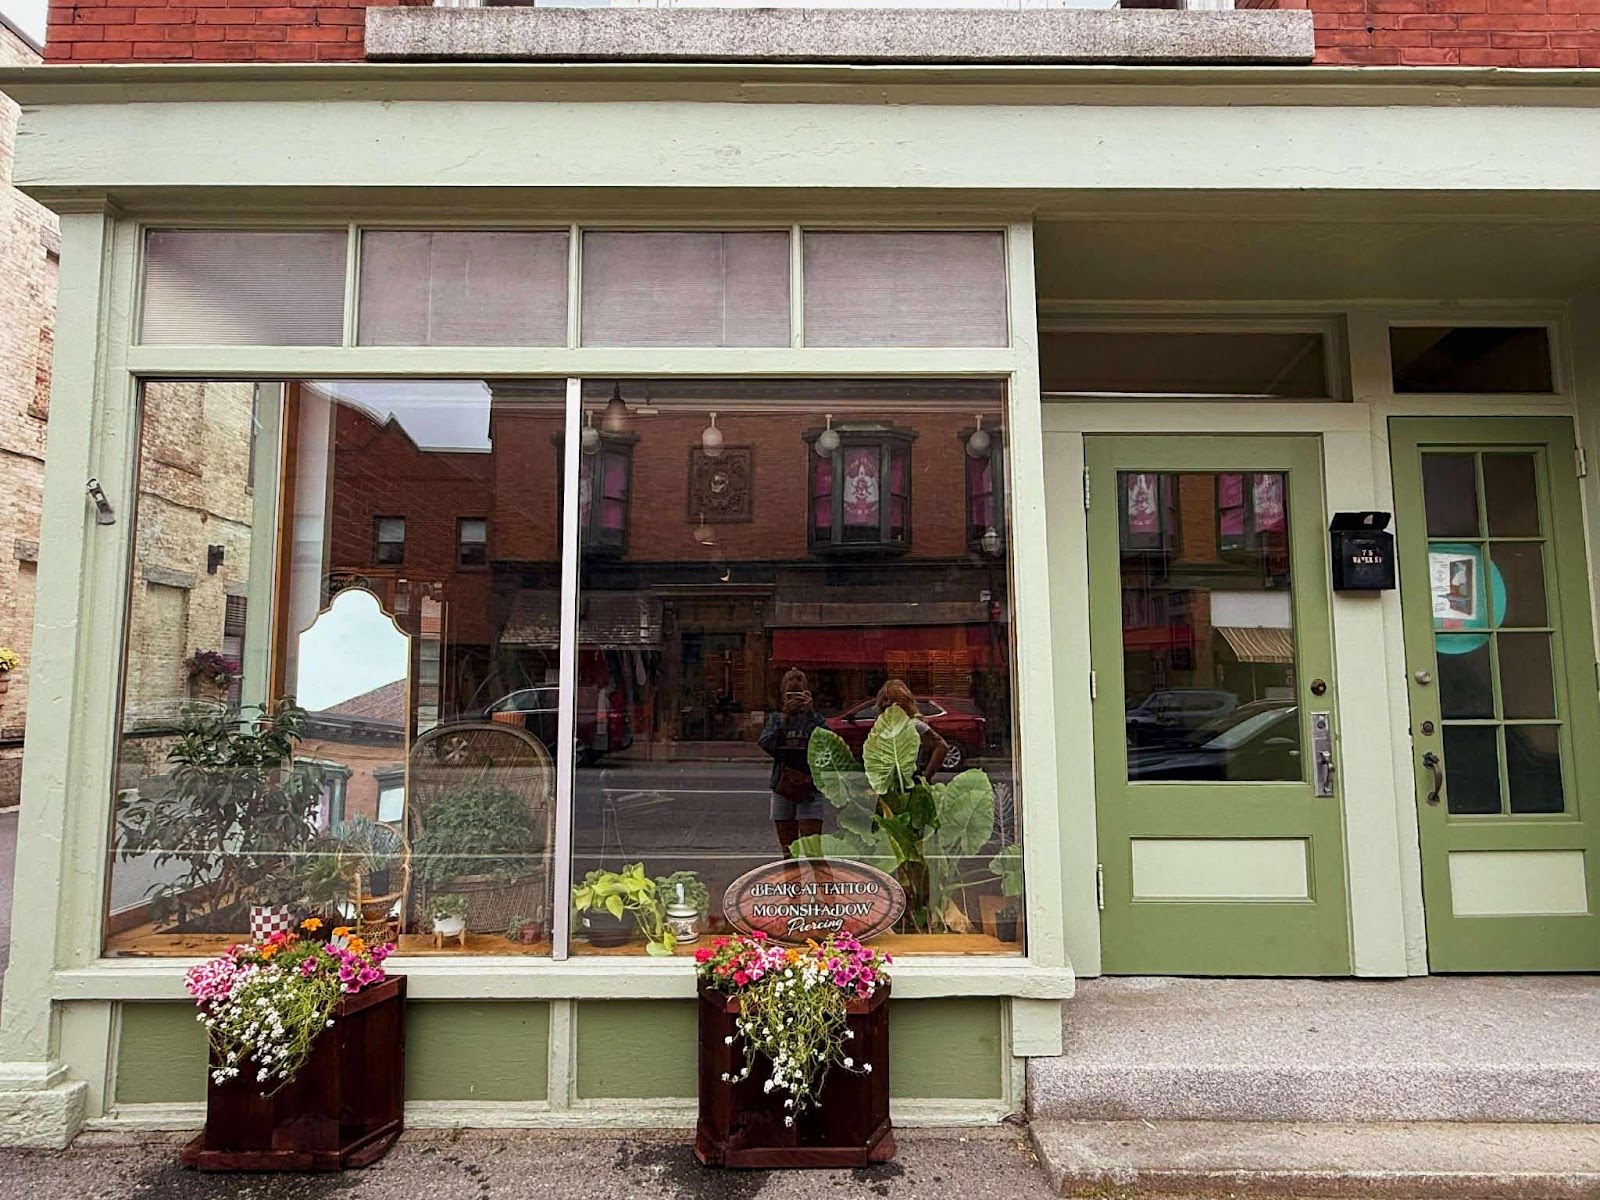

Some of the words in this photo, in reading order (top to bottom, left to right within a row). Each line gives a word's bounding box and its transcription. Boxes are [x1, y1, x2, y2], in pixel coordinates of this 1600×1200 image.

[751, 882, 819, 896] BEARCAT
[822, 882, 878, 895] TATTOO
[753, 902, 873, 916] MOONSHADOW
[787, 917, 844, 935] Piercing
